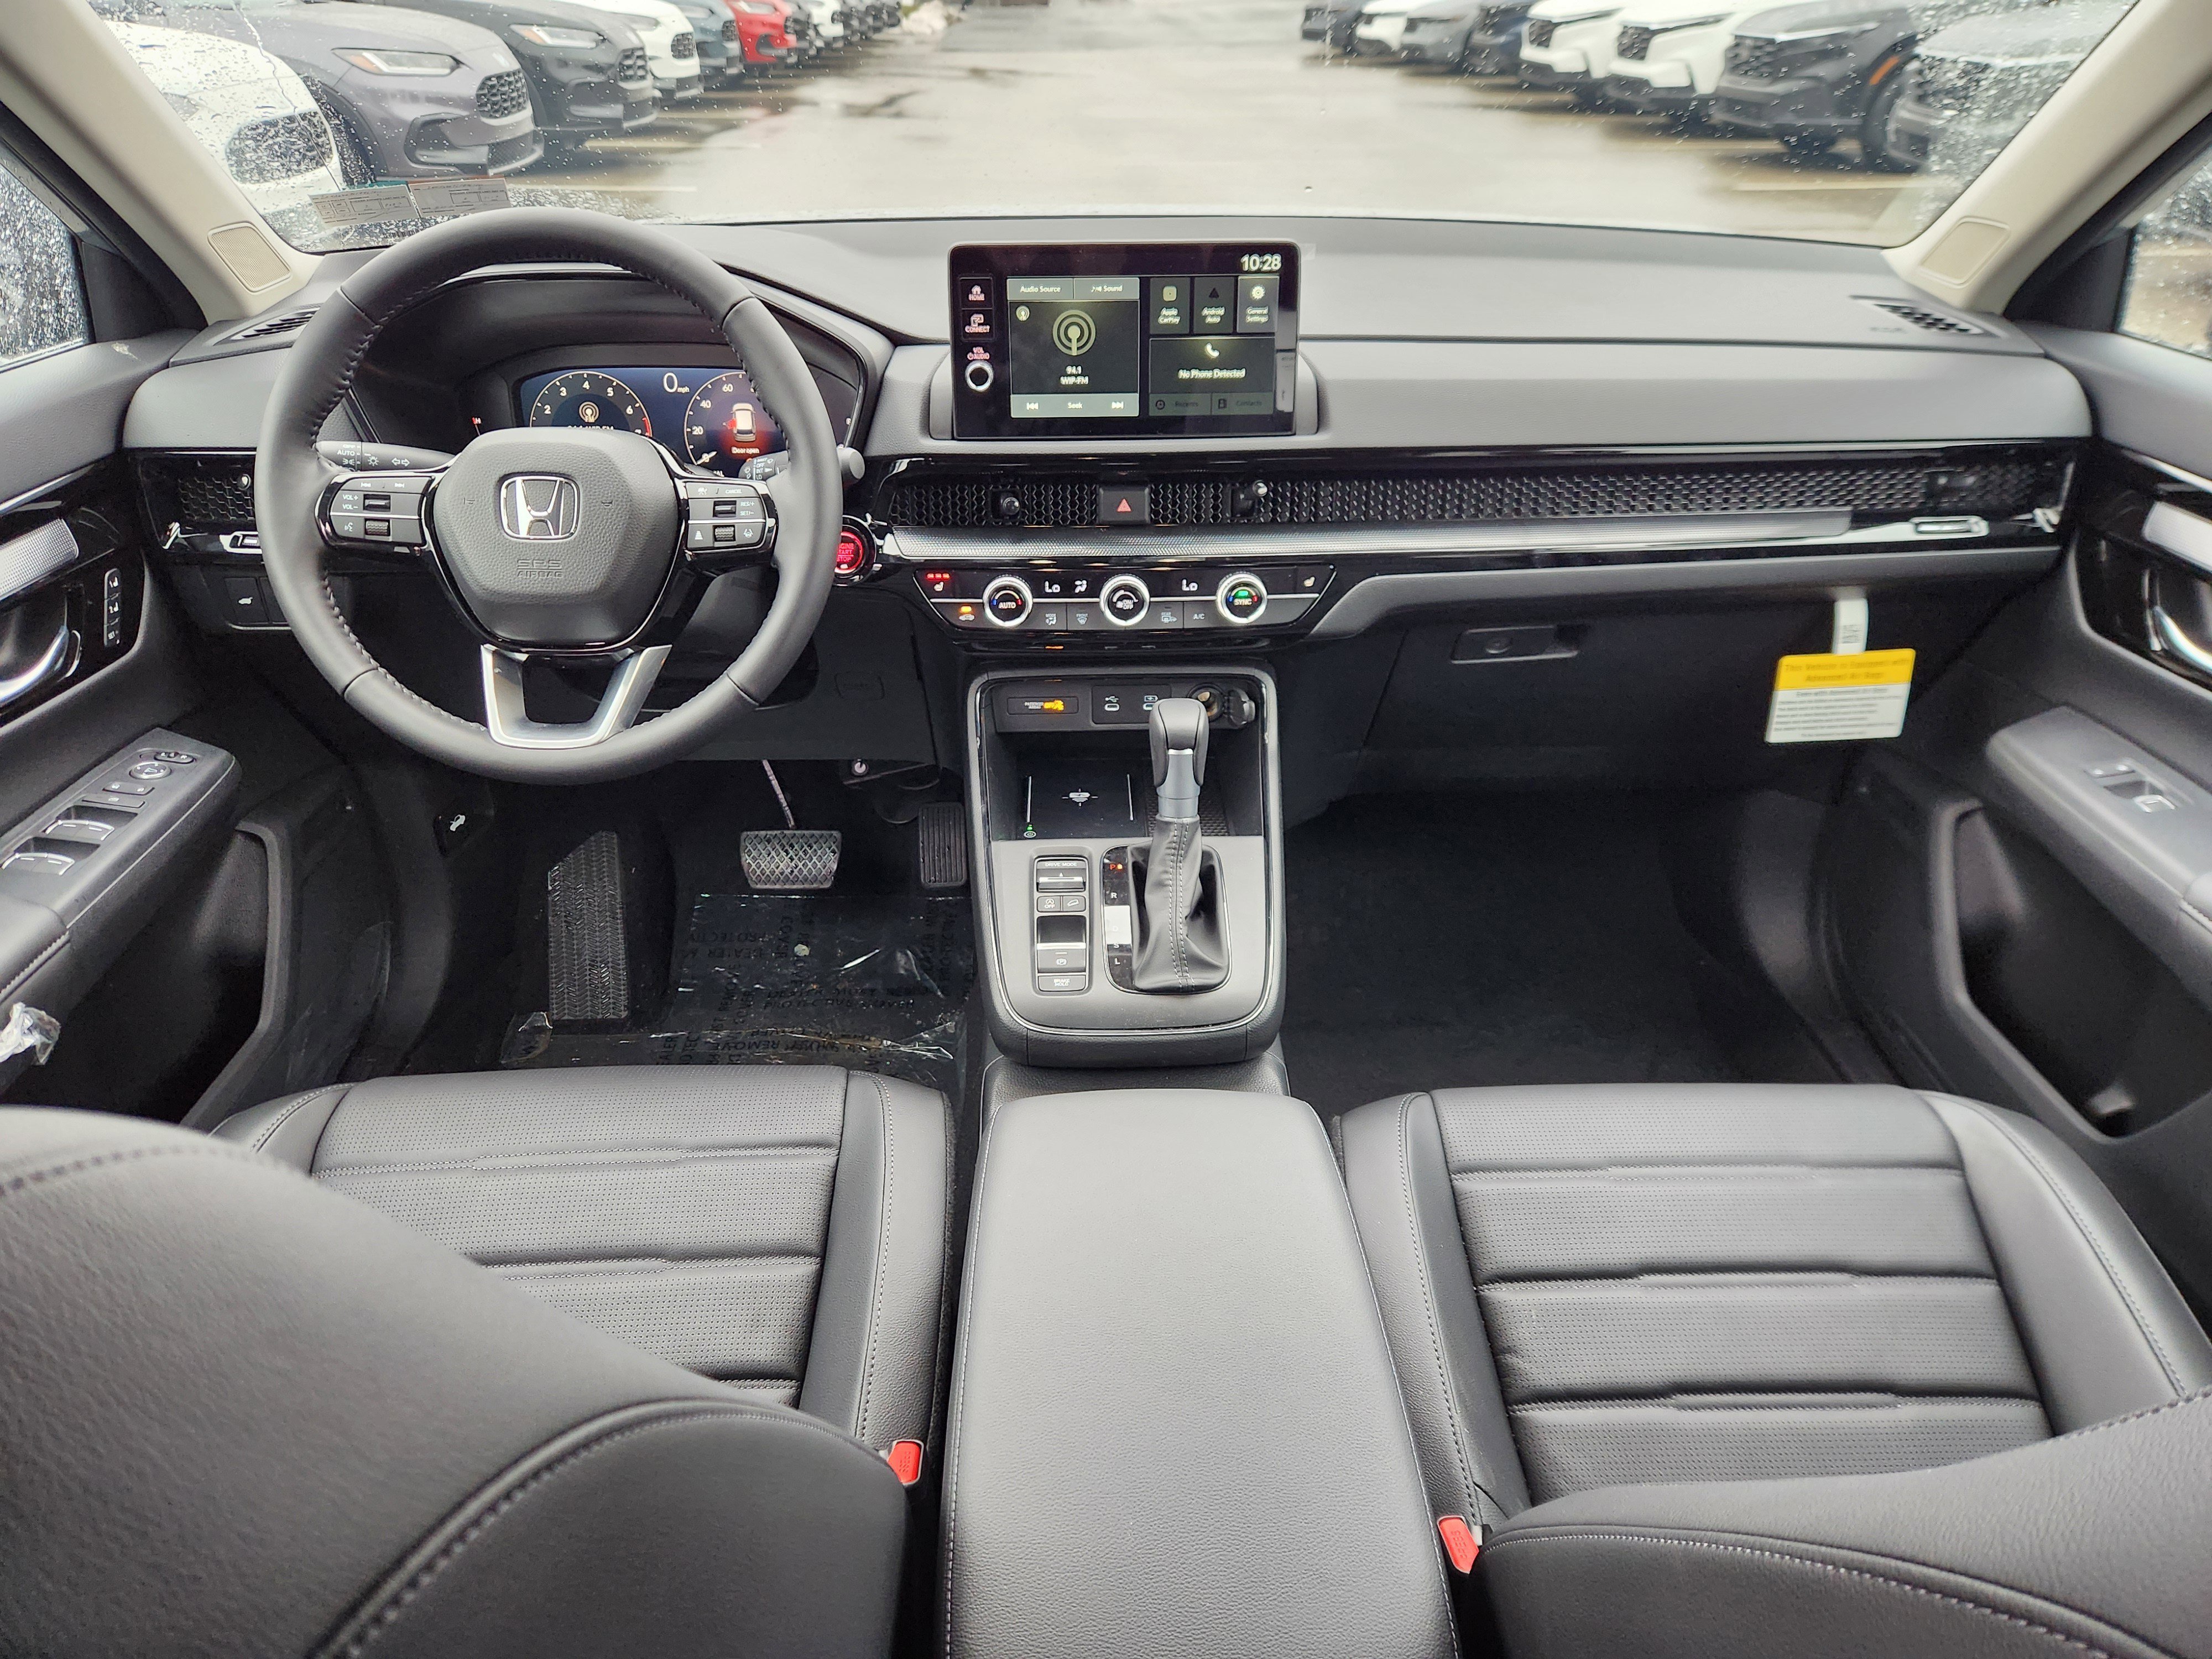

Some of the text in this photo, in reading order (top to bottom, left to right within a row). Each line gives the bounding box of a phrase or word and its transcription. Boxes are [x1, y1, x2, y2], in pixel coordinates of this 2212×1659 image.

[1240, 254, 1281, 271] 10:28
[1202, 307, 1225, 315] Android
[1178, 368, 1246, 378] No Phone Detected
[582, 380, 590, 390] 4
[663, 372, 678, 393] 0
[559, 387, 567, 397] 3
[607, 387, 614, 397] 5
[722, 384, 733, 392] 60
[700, 399, 712, 408] 40
[544, 405, 551, 414] 2
[625, 405, 633, 414] 6
[692, 426, 703, 435] 20
